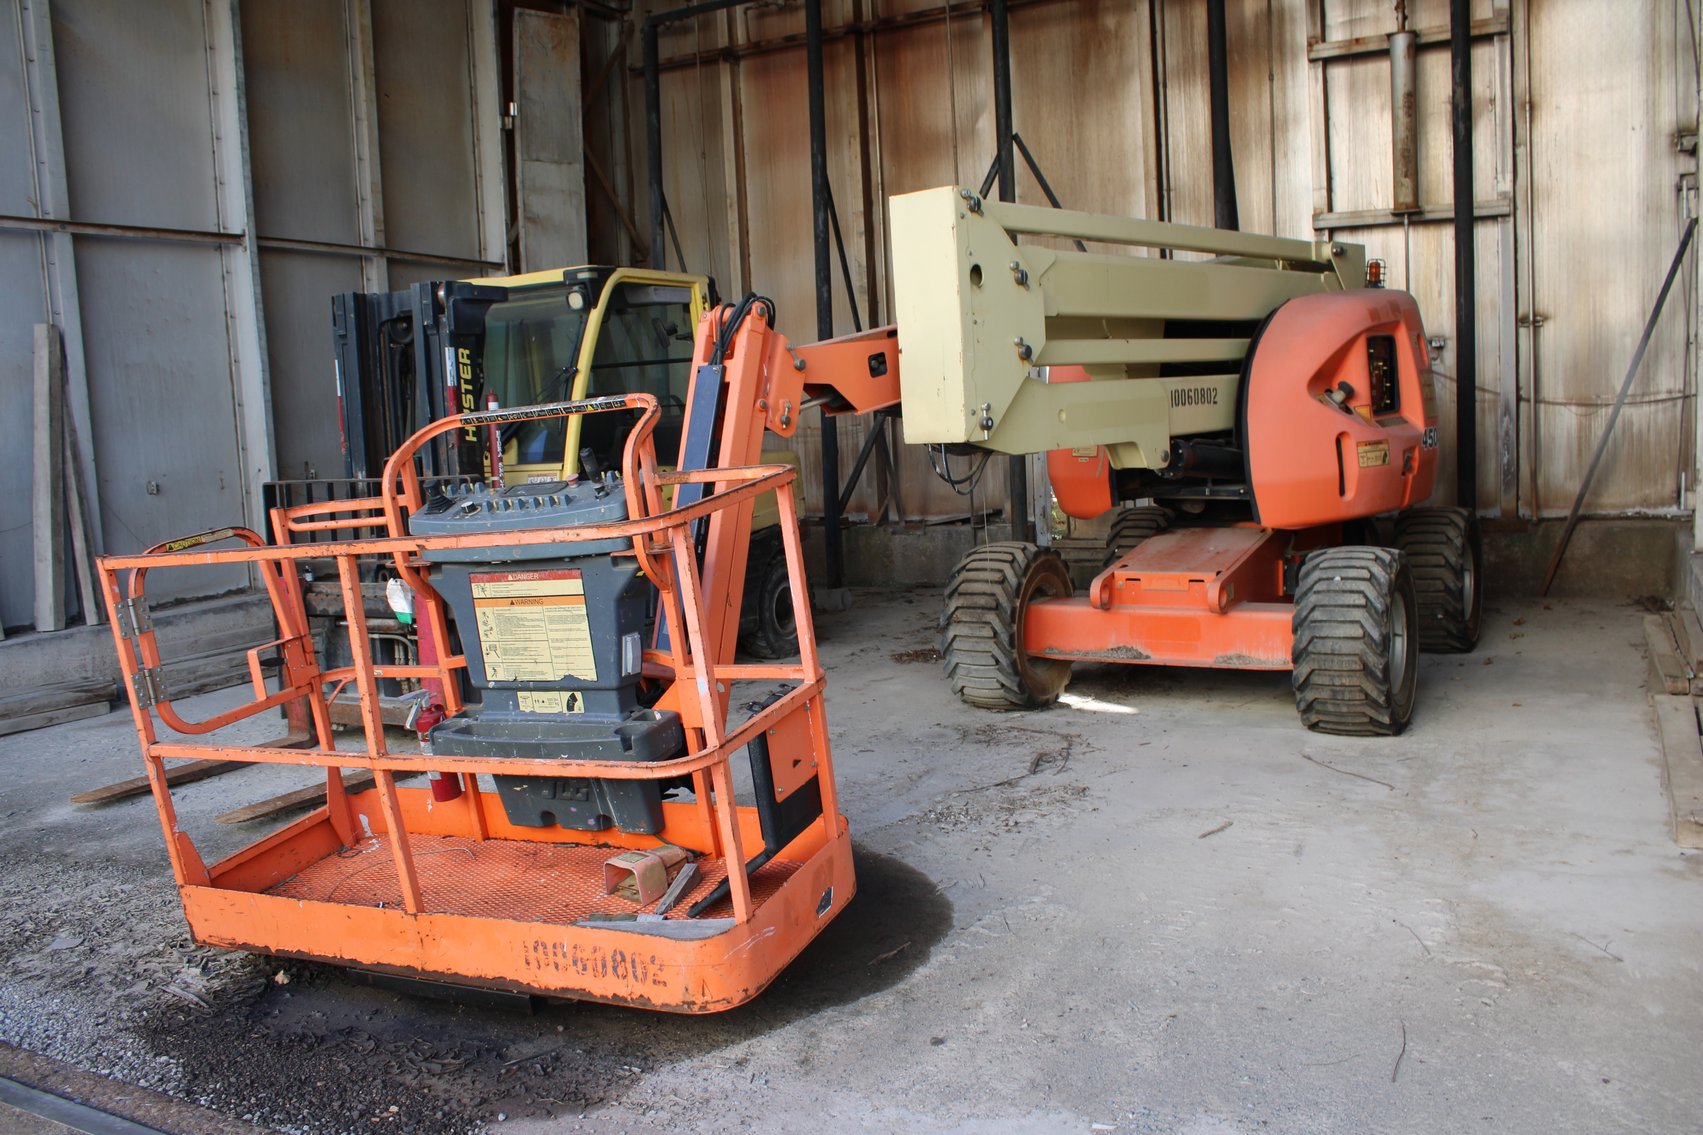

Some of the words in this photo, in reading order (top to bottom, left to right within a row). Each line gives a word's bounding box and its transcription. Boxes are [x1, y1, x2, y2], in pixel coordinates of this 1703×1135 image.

[458, 347, 478, 443] HSTER
[1170, 386, 1218, 408] 10060802
[1422, 427, 1439, 449] 450
[515, 598, 544, 606] WARNING
